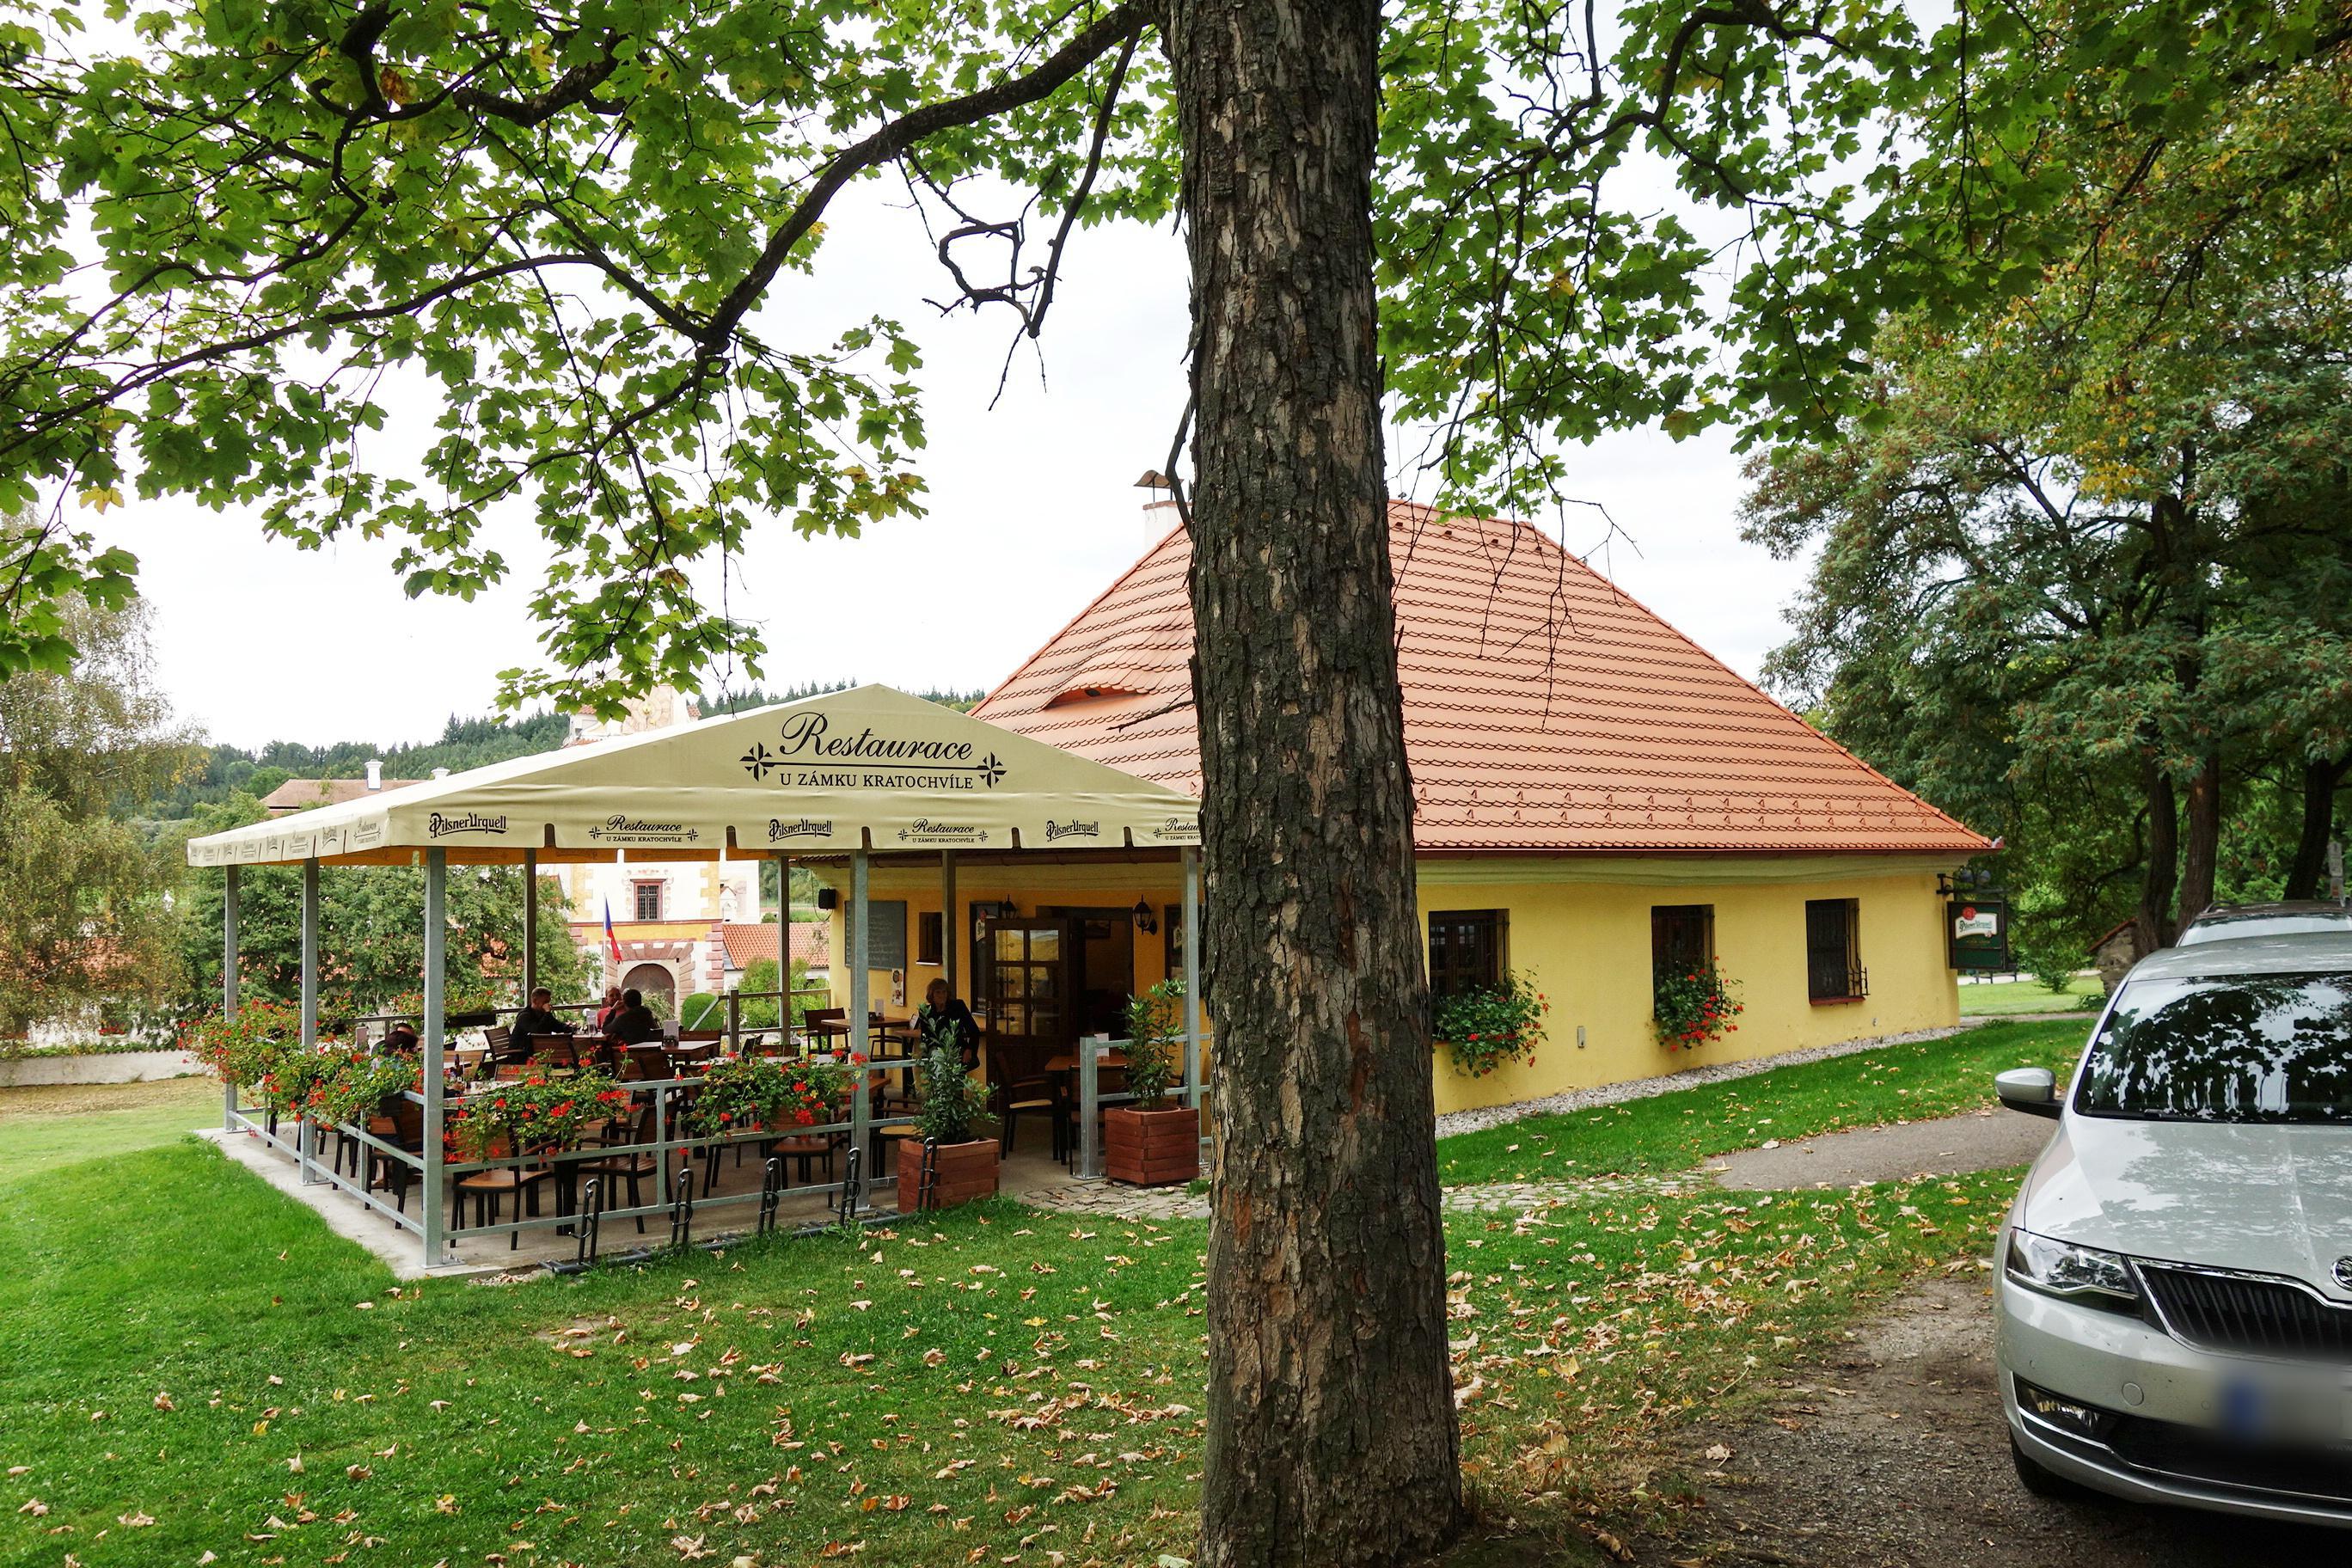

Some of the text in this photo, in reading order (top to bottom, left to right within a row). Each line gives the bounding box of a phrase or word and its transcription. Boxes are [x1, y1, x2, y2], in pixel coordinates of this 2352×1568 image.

[779, 712, 973, 761] Restaurace
[780, 770, 973, 789] U ZÁMKU KRATOCHVÍLE
[429, 812, 506, 838] Pilsner Urquell
[606, 814, 682, 831] Restaurace
[769, 818, 832, 842] Pilsner Urquell
[912, 818, 975, 833] Restaurace
[1046, 819, 1099, 842] Pilsner Urquell
[1165, 818, 1199, 832] Restau
